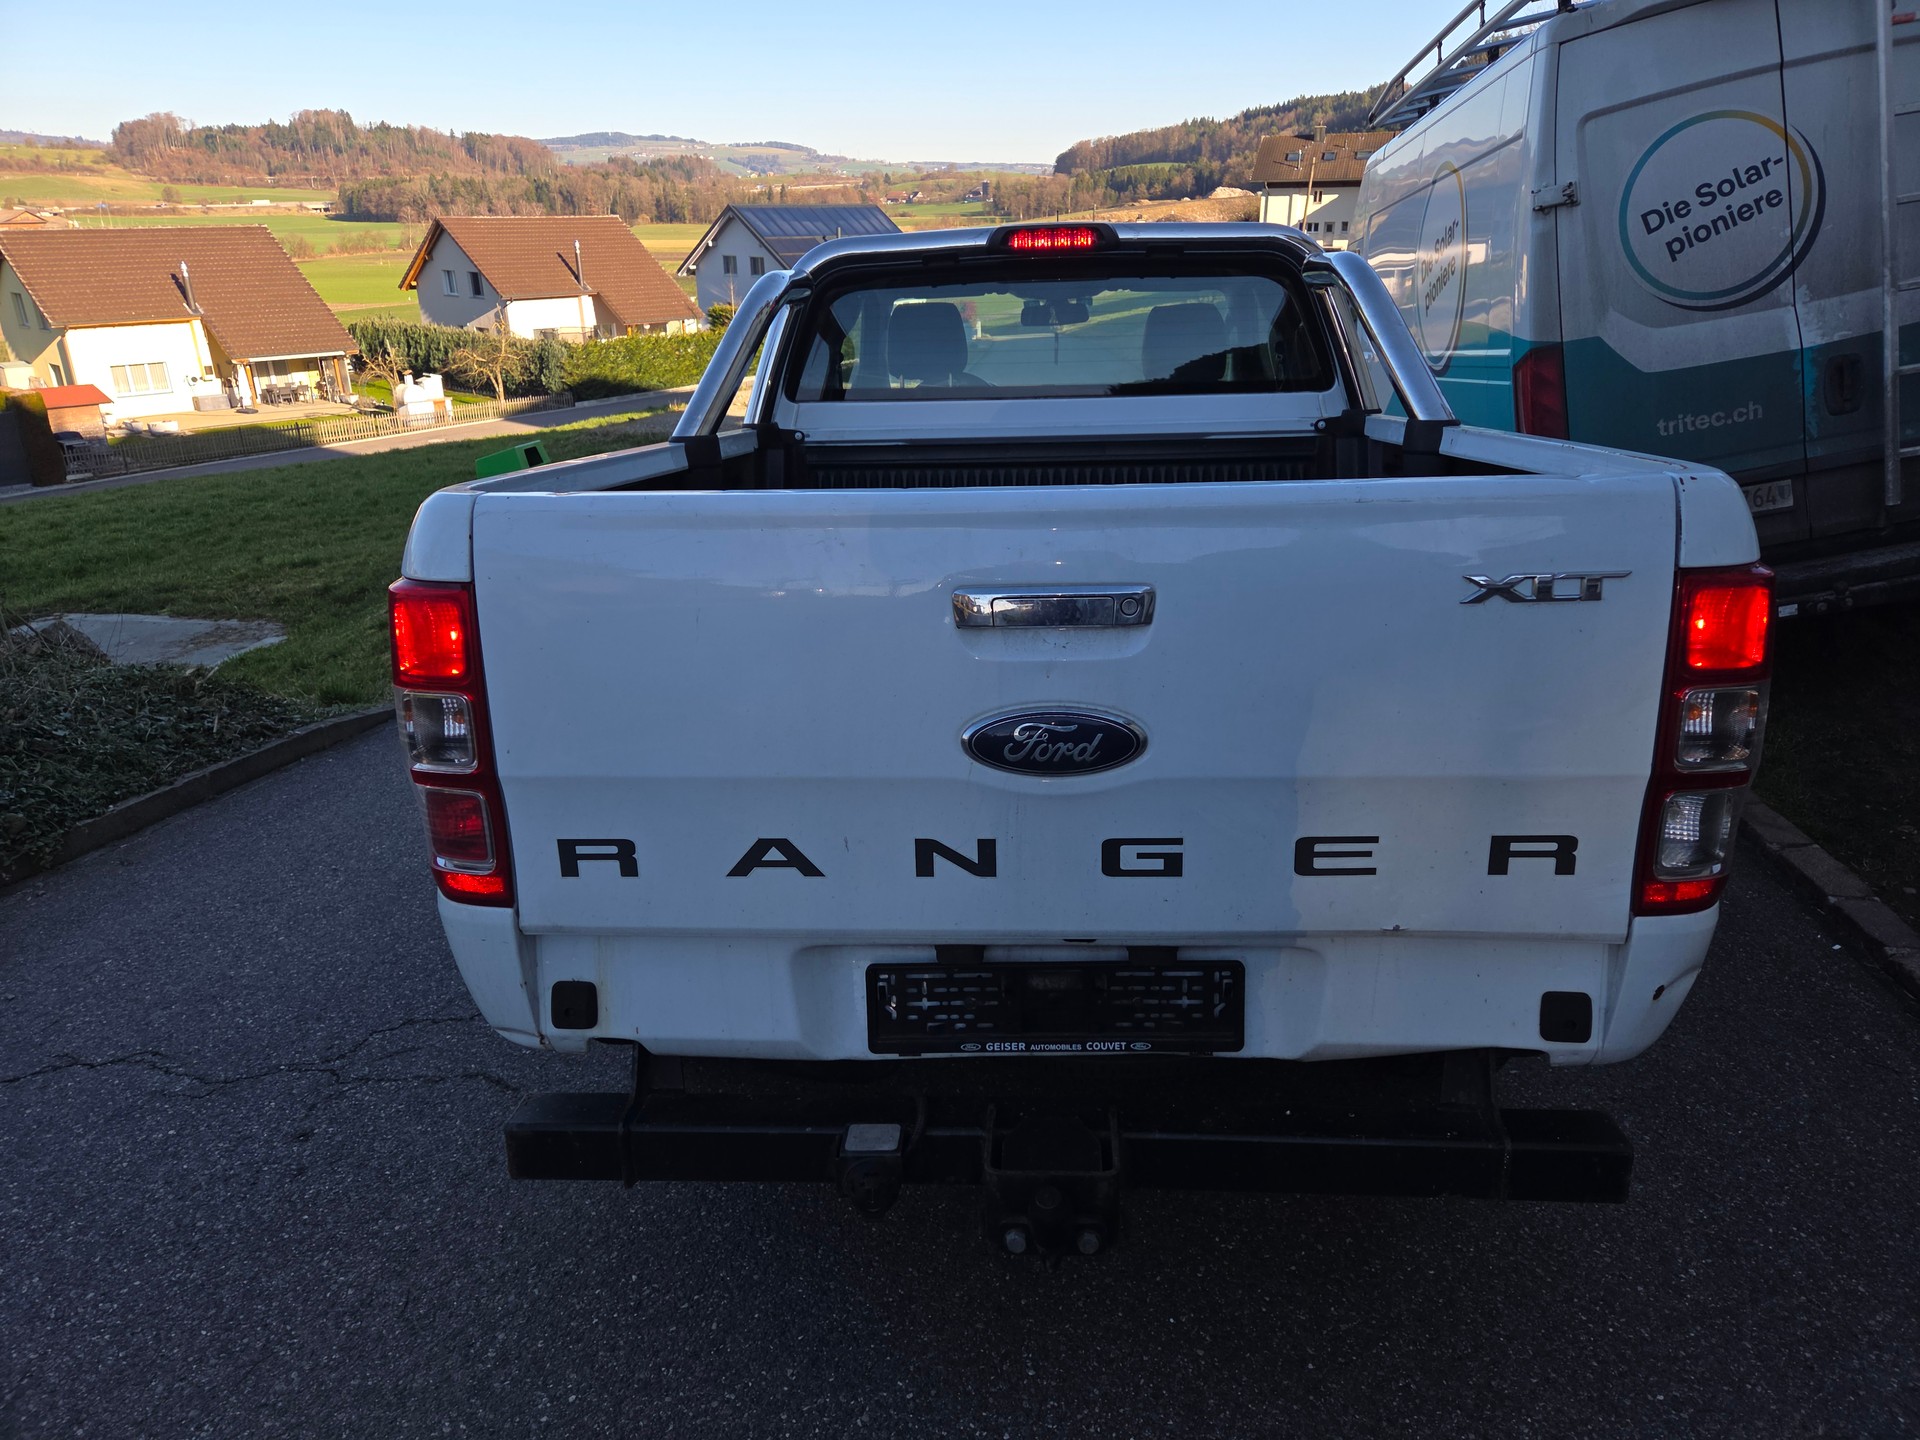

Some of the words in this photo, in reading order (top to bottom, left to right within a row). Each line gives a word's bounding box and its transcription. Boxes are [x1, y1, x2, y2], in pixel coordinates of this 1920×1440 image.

[1640, 200, 1692, 236] Die
[1695, 156, 1784, 207] Solar-
[1665, 189, 1784, 263] pioniere
[1421, 254, 1434, 285] Die
[1434, 218, 1460, 264] Solar-
[1424, 255, 1457, 318] pioniere
[1656, 400, 1763, 437] tritec.ch
[1459, 570, 1633, 604] XLT
[1003, 722, 1104, 763] Ford
[556, 834, 1580, 878] RANGER
[985, 1042, 1026, 1051] GEISER
[1030, 1043, 1082, 1051] AUTOMOBILES
[1086, 1041, 1127, 1051] COUVET
